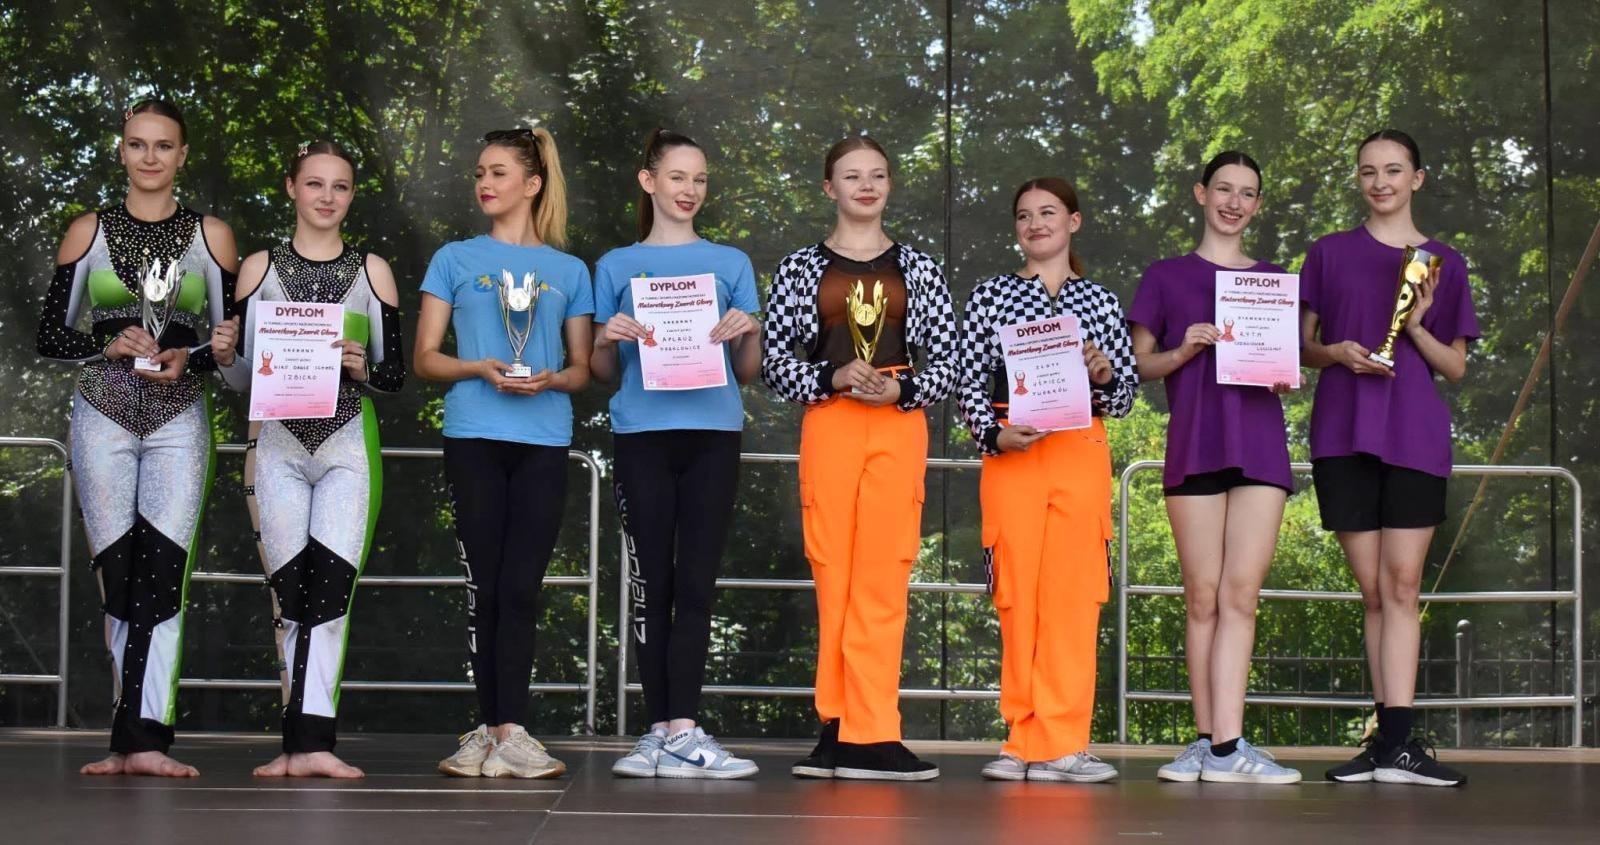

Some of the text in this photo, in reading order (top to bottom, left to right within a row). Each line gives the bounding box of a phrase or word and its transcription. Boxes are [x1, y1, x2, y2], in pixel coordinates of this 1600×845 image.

[650, 281, 696, 291] DYPLOM
[1235, 277, 1280, 287] DYPLOM
[276, 307, 324, 317] DYPLOM
[1016, 322, 1061, 337] DYPLOM
